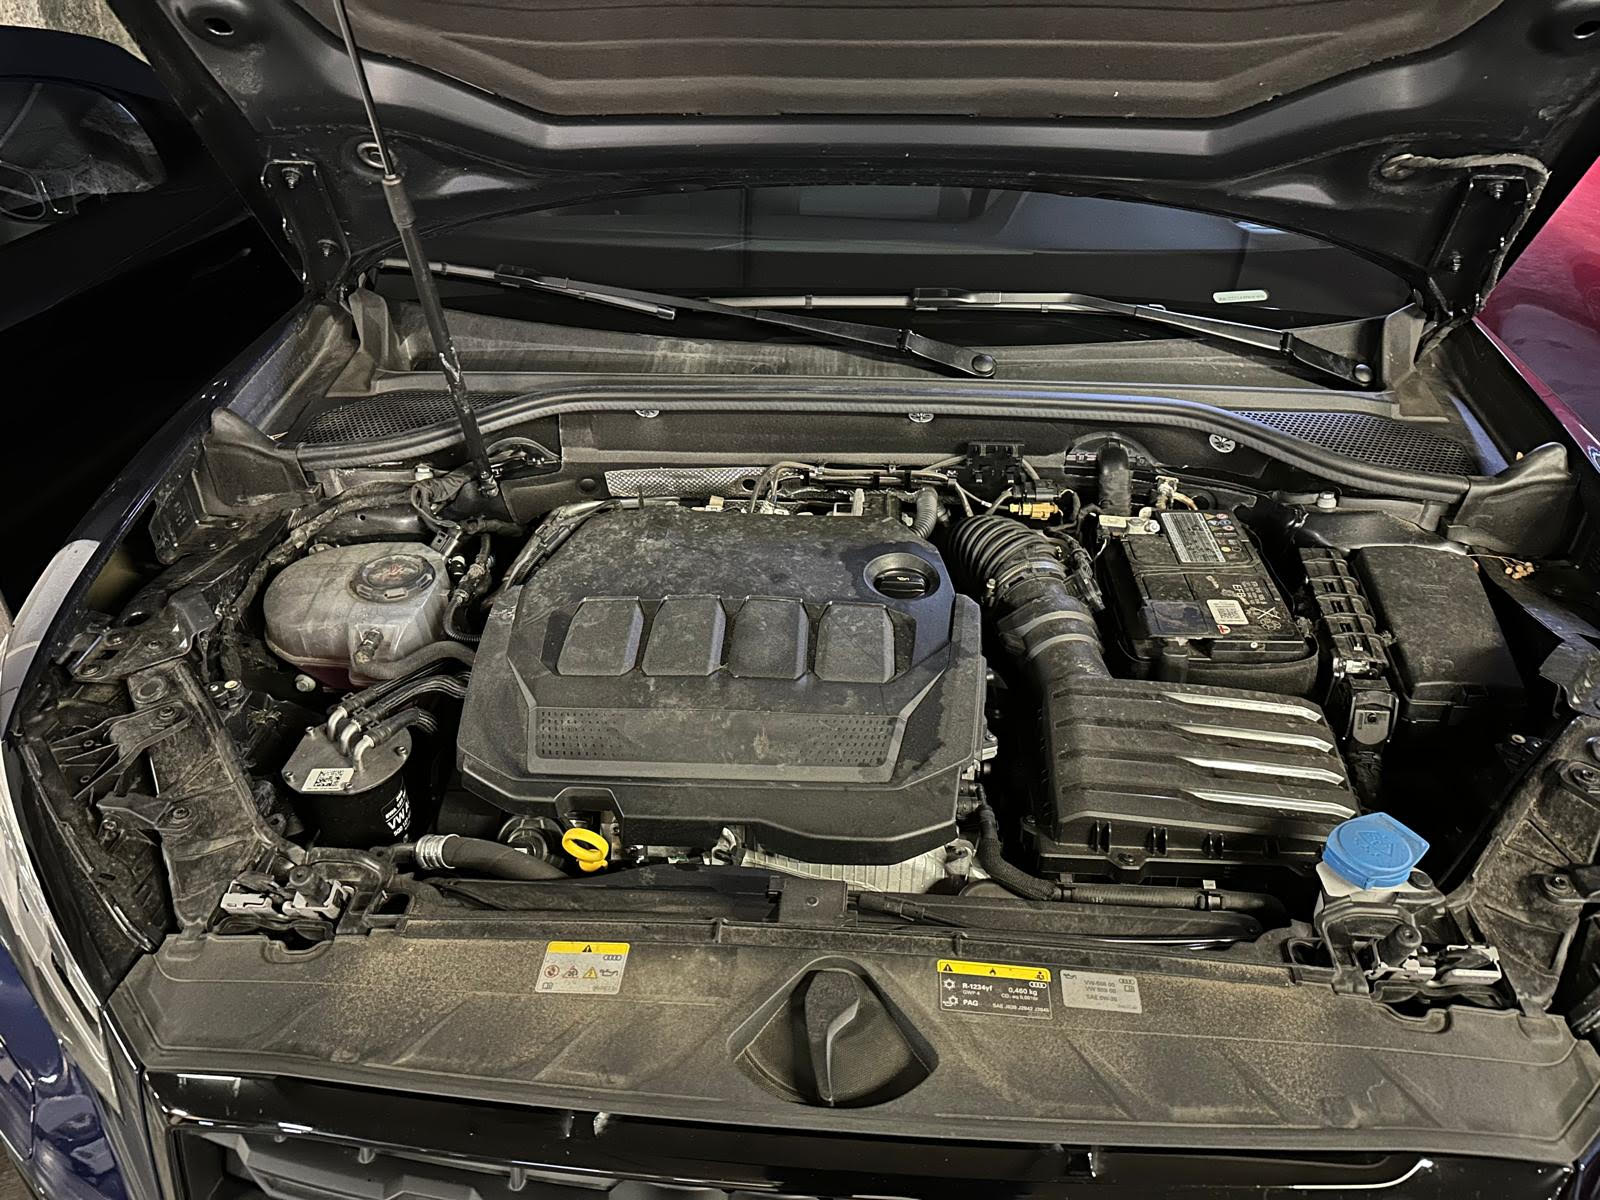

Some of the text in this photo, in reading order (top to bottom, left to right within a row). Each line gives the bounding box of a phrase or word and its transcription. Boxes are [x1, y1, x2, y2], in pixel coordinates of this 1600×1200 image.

[1232, 584, 1247, 598] EFB
[387, 808, 405, 830] VW
[962, 983, 993, 992] R-1234yf
[963, 999, 979, 1007] PAG
